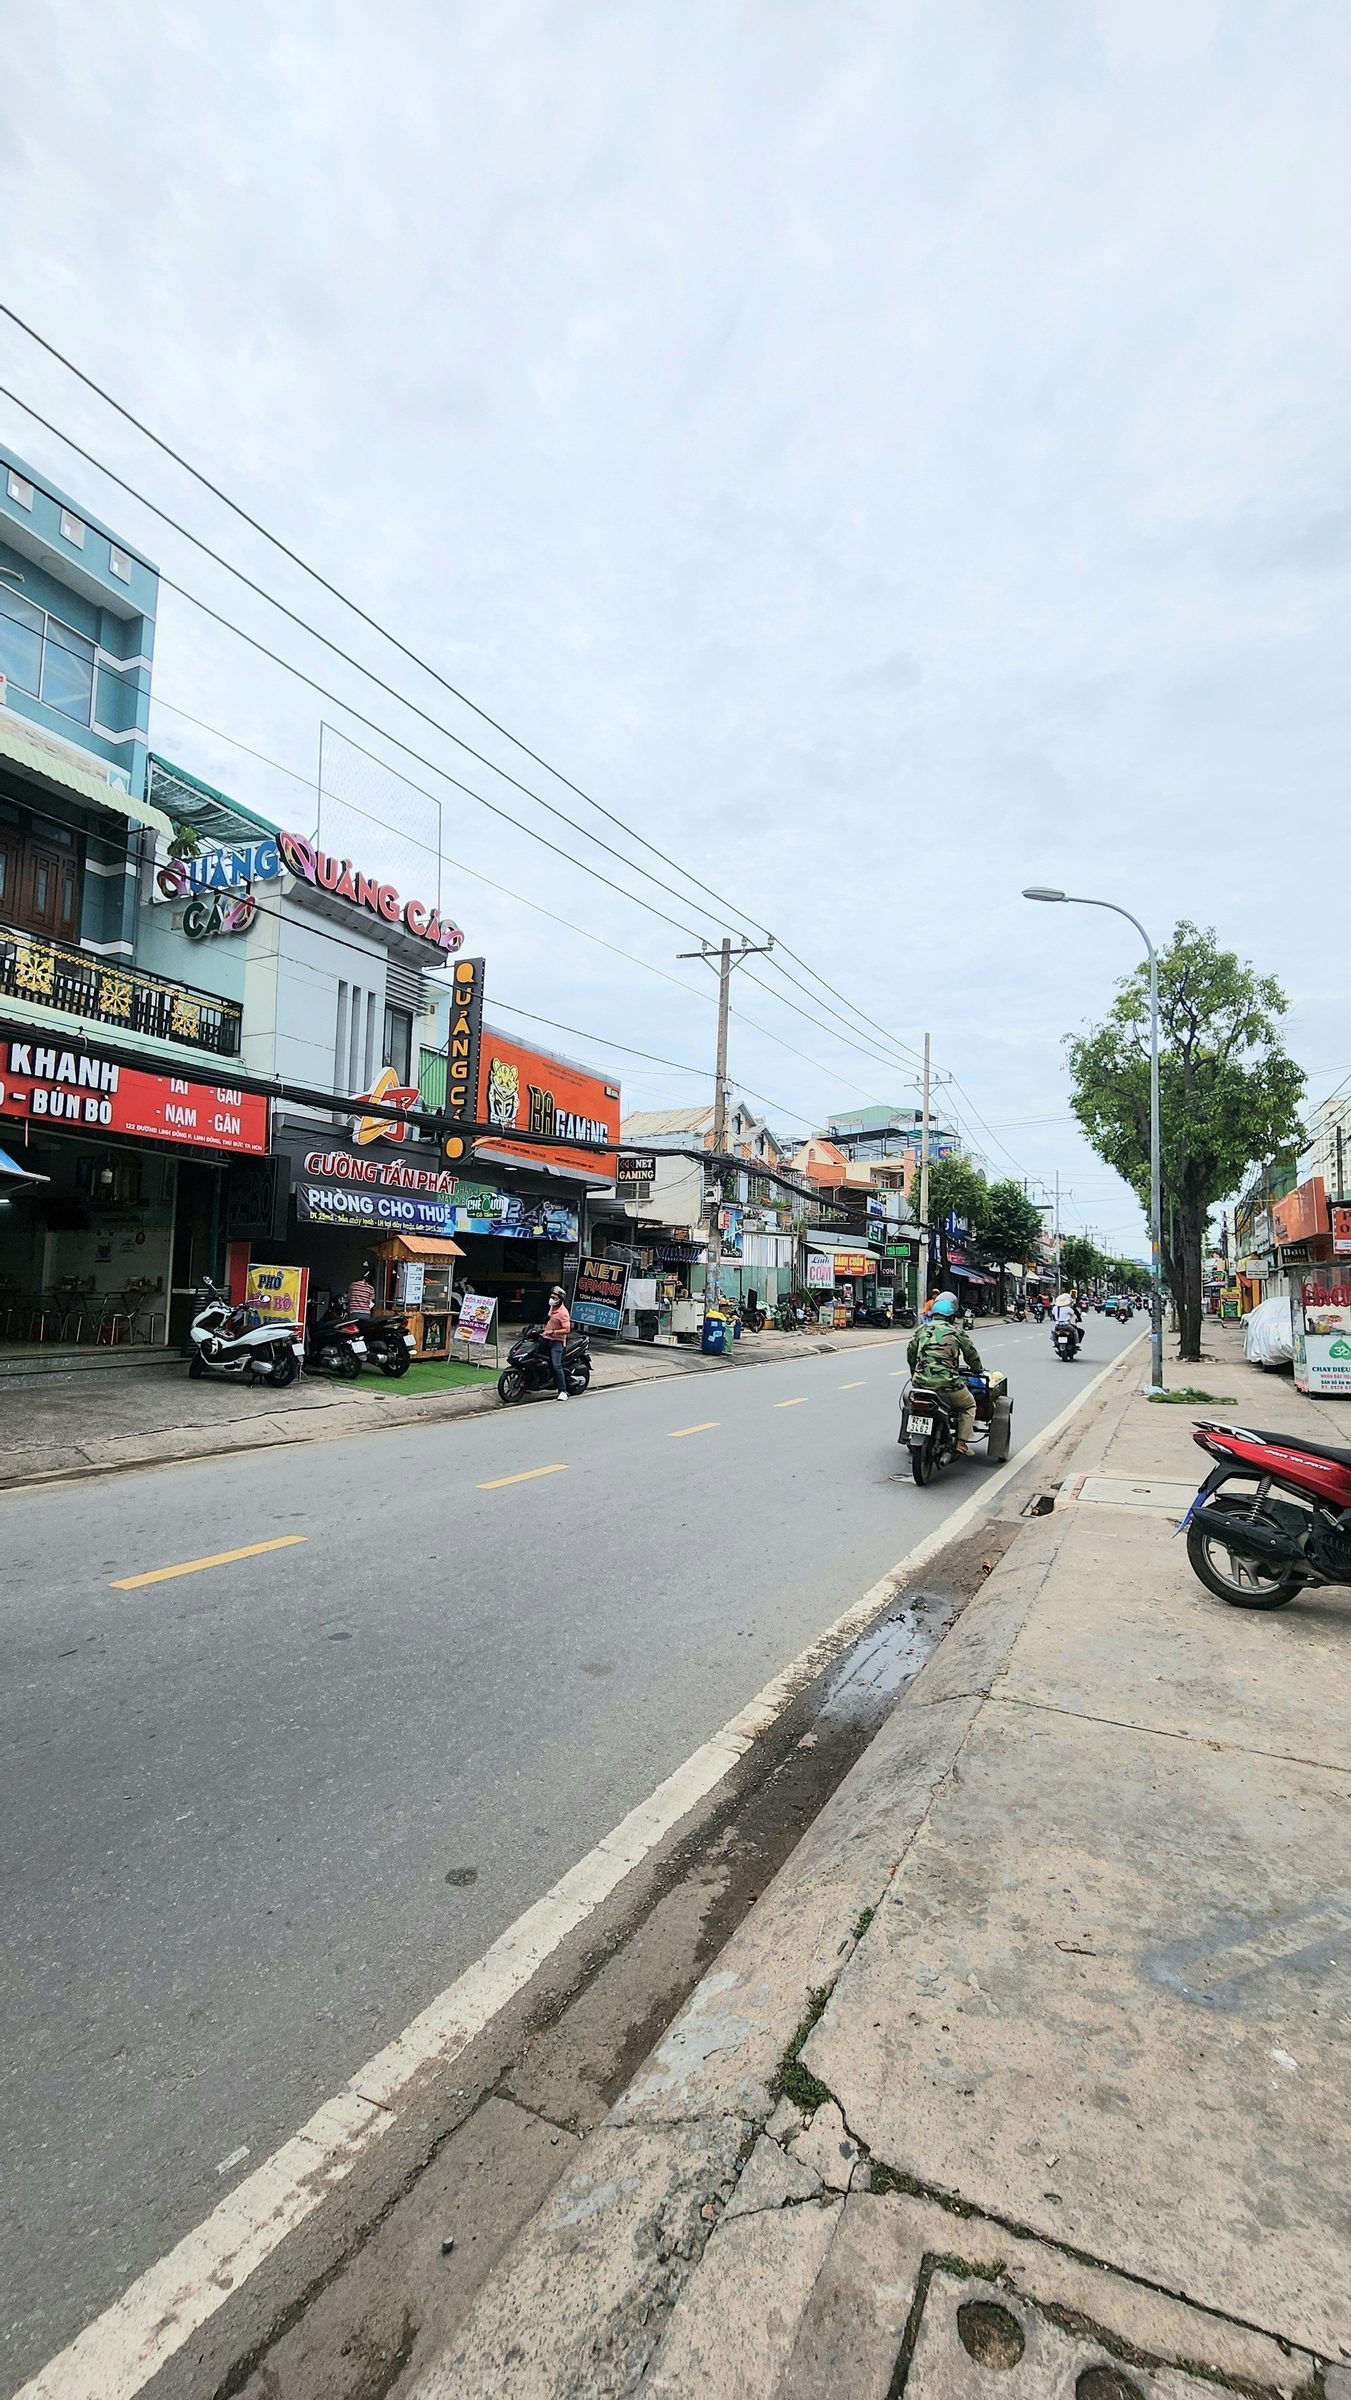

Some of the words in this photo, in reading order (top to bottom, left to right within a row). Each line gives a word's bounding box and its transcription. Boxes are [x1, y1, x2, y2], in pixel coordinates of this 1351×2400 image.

[157, 840, 280, 900] QUẢNG
[276, 831, 400, 922] QUẢNG
[404, 900, 465, 953] CÁO
[451, 962, 475, 1079] QUẢNG
[10, 1043, 120, 1093] KHANH
[32, 1086, 80, 1119] BÚN
[85, 1094, 113, 1125] BÒ
[165, 1103, 197, 1128] NẠM
[305, 1152, 377, 1183] CƯỜNG
[380, 1159, 414, 1188] TẤN
[416, 1170, 459, 1195] PHÁT
[619, 1170, 654, 1180] GAMING
[635, 1159, 653, 1169] NET
[308, 1187, 374, 1214] PHÒNG
[378, 1201, 415, 1219] CHO
[417, 1203, 451, 1223] THUÊ
[578, 1277, 622, 1297] GAMING
[584, 1261, 623, 1281] NET
